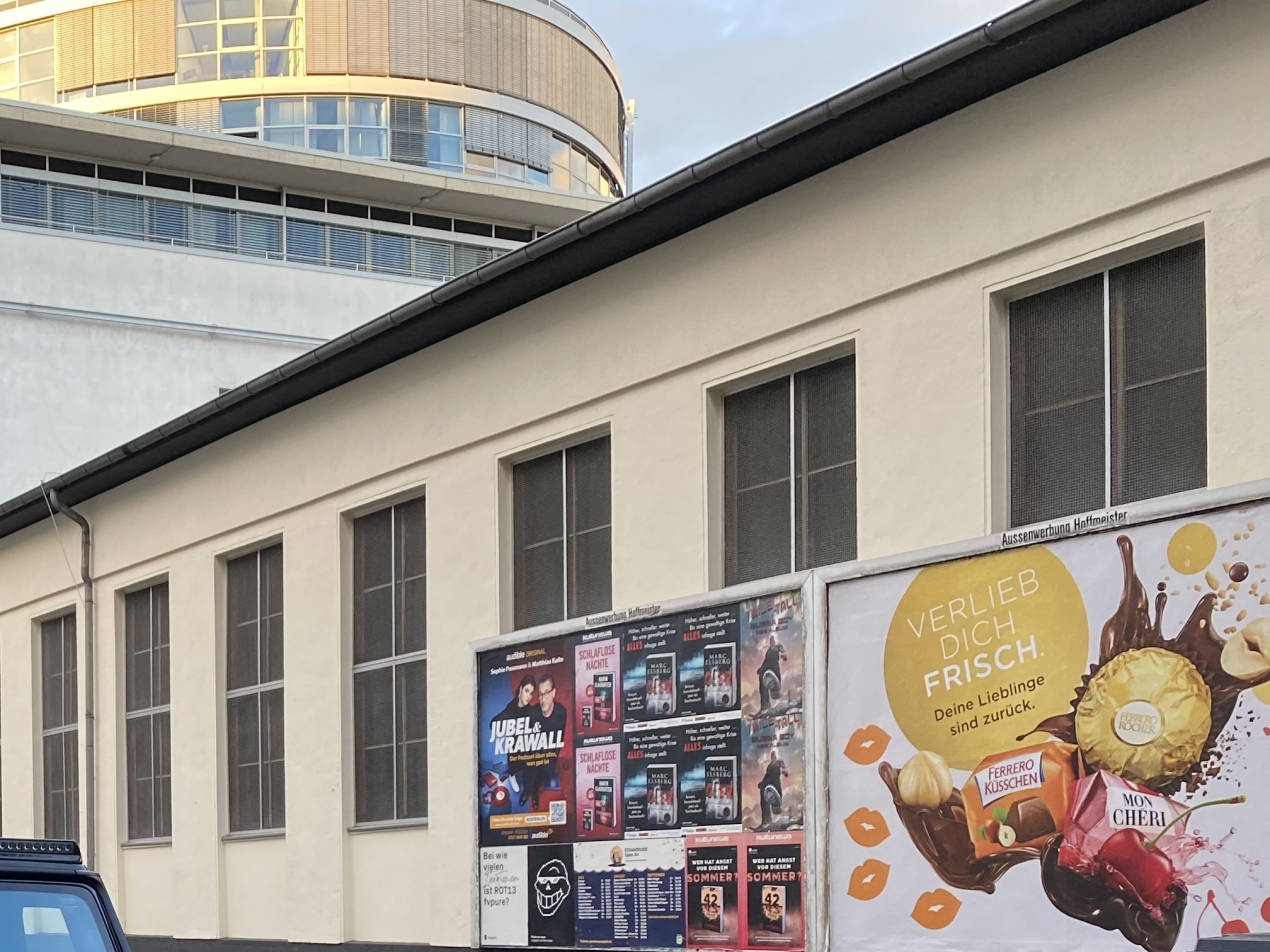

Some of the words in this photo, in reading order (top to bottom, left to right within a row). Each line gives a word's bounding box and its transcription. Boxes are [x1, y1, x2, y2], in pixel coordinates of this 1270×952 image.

[1002, 523, 1071, 546] Aussenwerbung
[1074, 511, 1128, 531] Hoffmeister
[775, 597, 799, 614] TALL
[907, 569, 1039, 638] VERLIEB
[683, 631, 700, 641] ALLES
[940, 611, 1015, 660] DICH
[579, 644, 616, 660] SCHLAFLOSE
[626, 641, 643, 651] ALLES
[506, 651, 526, 661] audible
[526, 648, 546, 658] ORIGINAL
[490, 667, 506, 675] Sophie
[532, 658, 552, 668] Matthias
[586, 657, 609, 671] NÄCHTE
[924, 635, 1044, 698] FRISCH.
[934, 700, 974, 722] Deine
[978, 676, 1045, 706] Lieblinge
[775, 714, 799, 730] TALL
[950, 716, 978, 736] sind
[984, 699, 1036, 726] zurück.
[1120, 712, 1158, 725] FERRERO
[489, 717, 532, 743] JUBEL
[533, 722, 542, 733] &
[1118, 721, 1156, 734] ROCHER
[494, 730, 564, 755] KRAWALL
[684, 742, 702, 752] ALLES
[580, 750, 616, 763] SCHLAFLOSE
[627, 750, 644, 760] ALLES
[586, 762, 610, 774] NÄCHTE
[988, 759, 1034, 780] FERRERO
[984, 772, 1038, 796] KÜSSCHEN
[1122, 793, 1153, 808] MON
[1113, 808, 1166, 827] CHÉRI
[484, 852, 494, 860] Bei
[496, 852, 508, 860] wie
[484, 863, 504, 871] vielen
[687, 872, 738, 883] SOMMER?
[747, 872, 802, 882] SOMMER?
[484, 886, 493, 894] ist
[494, 886, 516, 894] ROT13
[484, 898, 510, 907] fvpure?
[704, 894, 718, 906] 42
[764, 893, 780, 906] 42
